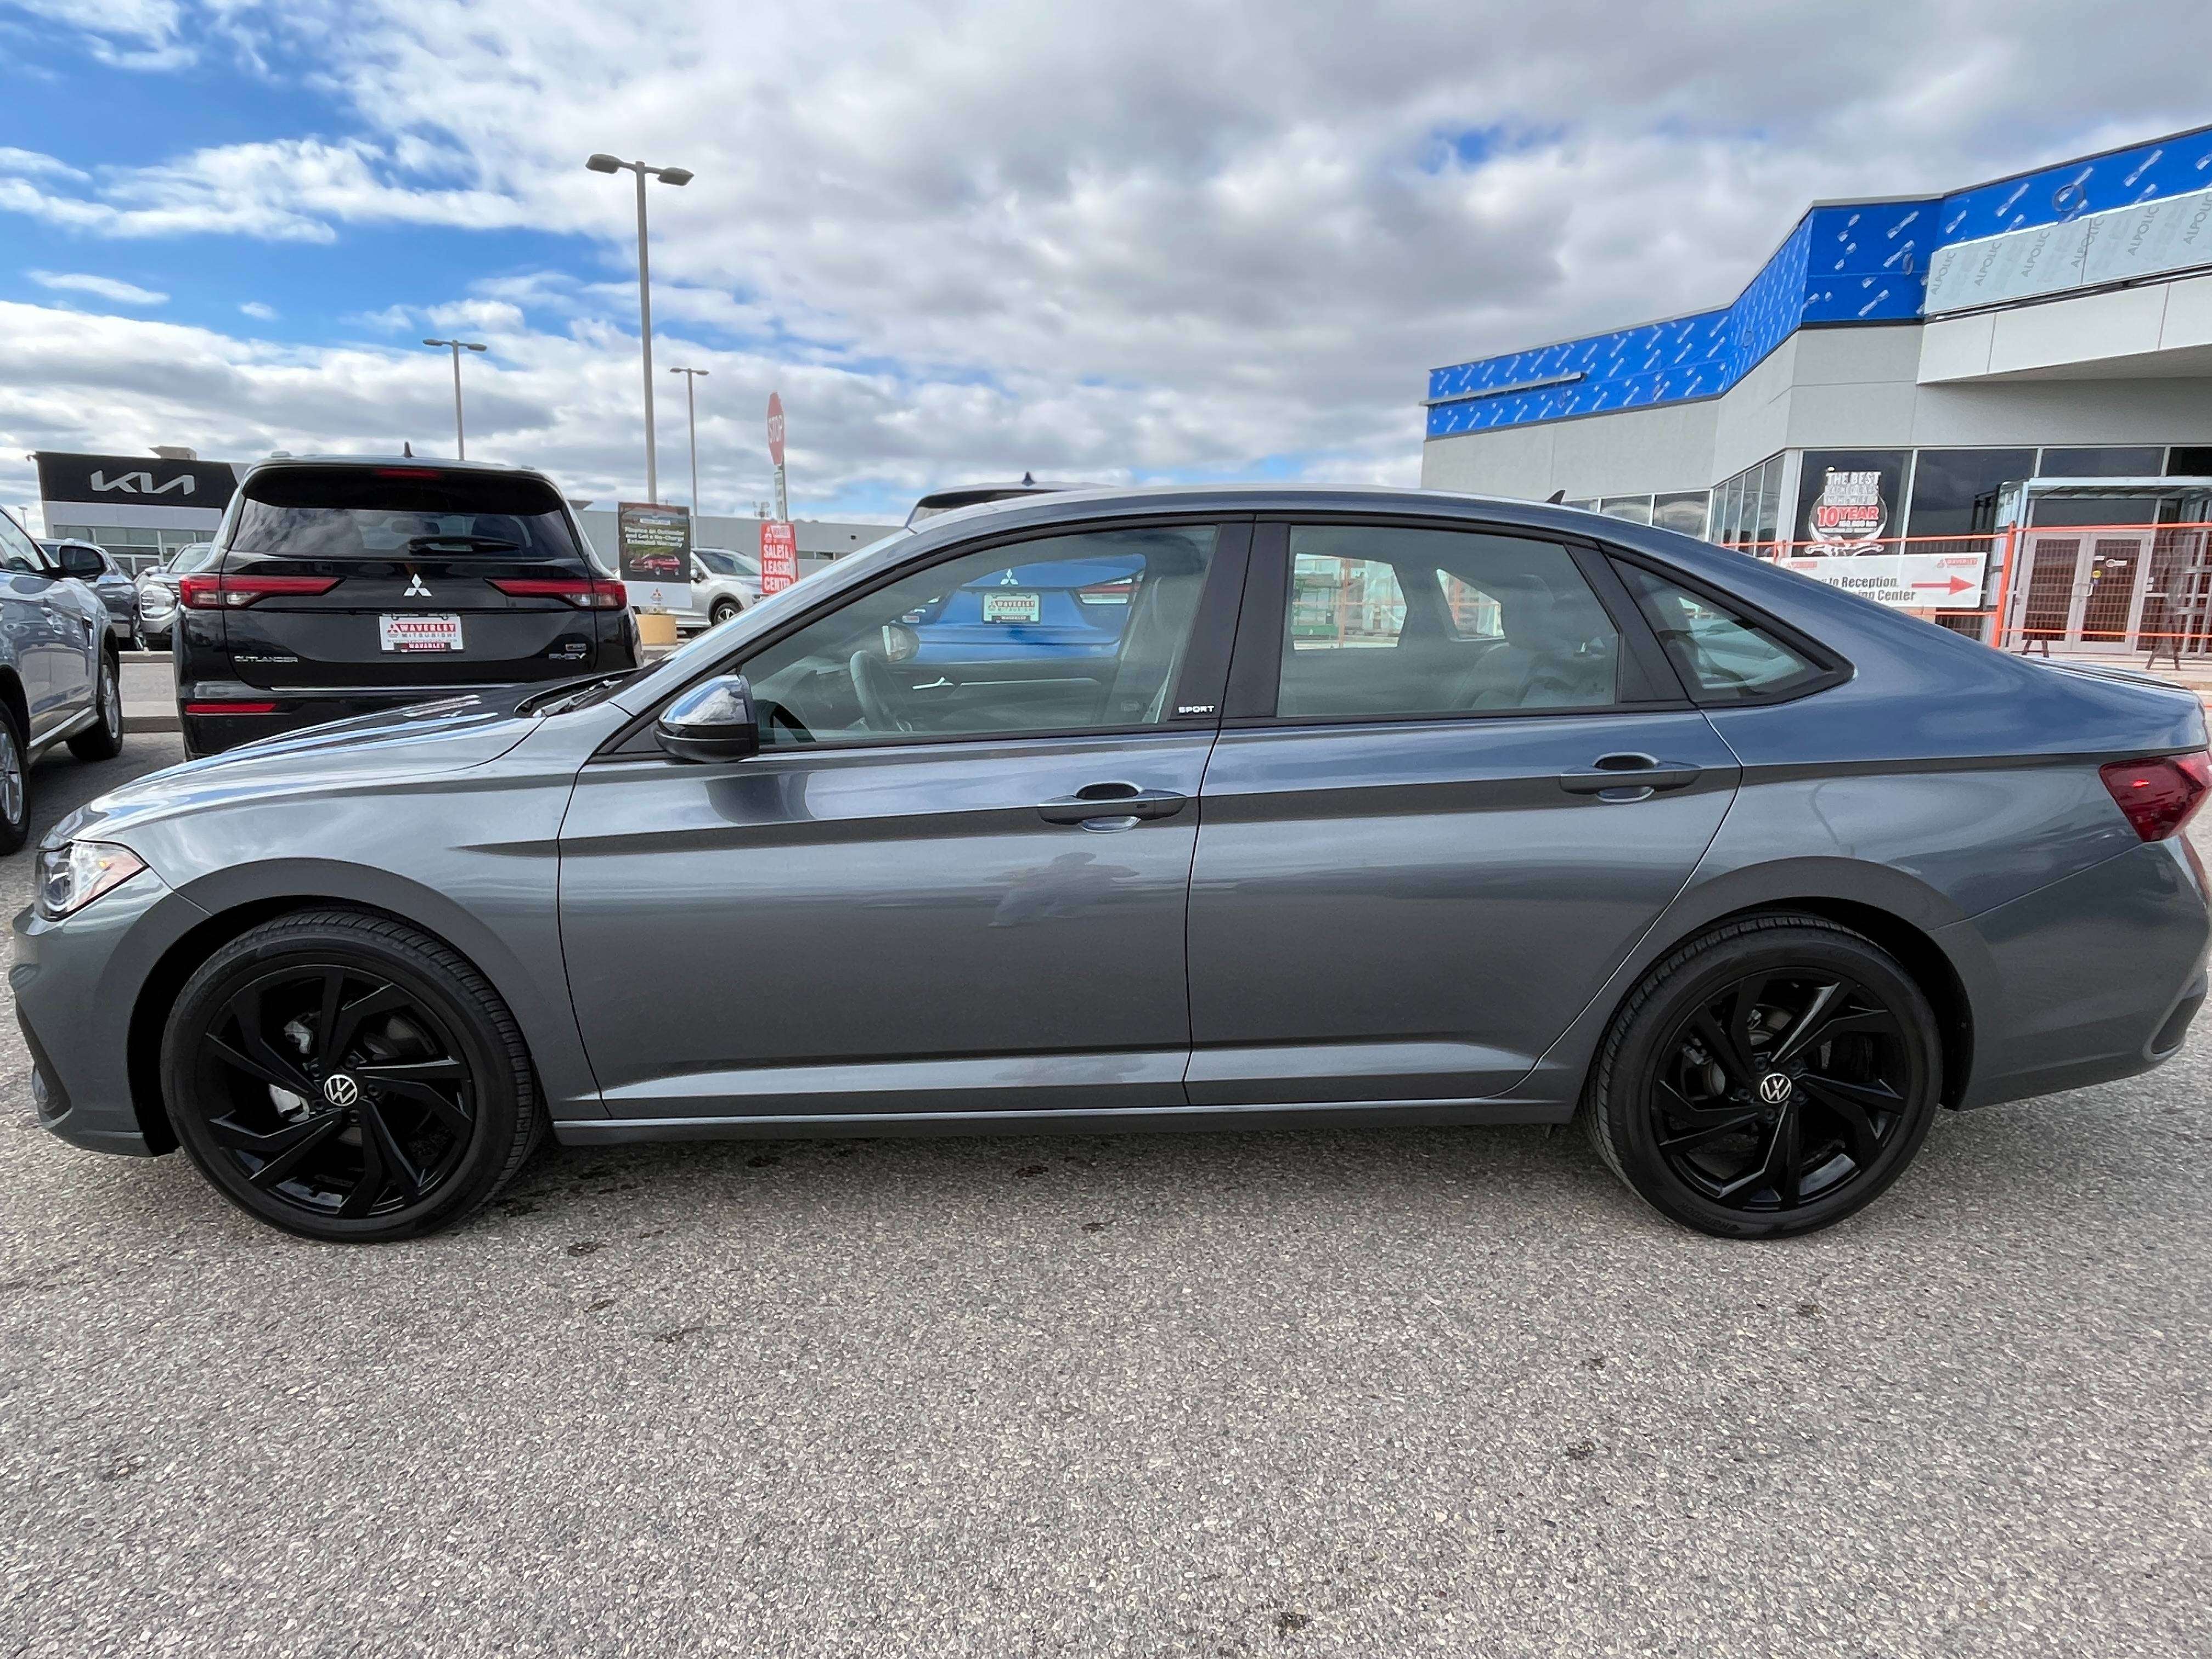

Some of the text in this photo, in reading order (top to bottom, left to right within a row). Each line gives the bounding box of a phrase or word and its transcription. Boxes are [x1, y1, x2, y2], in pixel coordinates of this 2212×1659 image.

[2127, 206, 2159, 256] ALPOLIC
[1974, 240, 2003, 286] ALPOLIC
[2021, 230, 2051, 278] ALPOLIC
[1931, 250, 1957, 295] ALPOLIC
[769, 415, 783, 444] STOP
[90, 470, 195, 495] KIA
[1826, 471, 1882, 485] THE BEST
[1817, 506, 1880, 527] 10 YEAR
[1842, 576, 1897, 588] Reception
[1877, 589, 1916, 601] Center
[399, 623, 456, 631] WAVERLEY
[1178, 705, 1215, 713] SPORT
